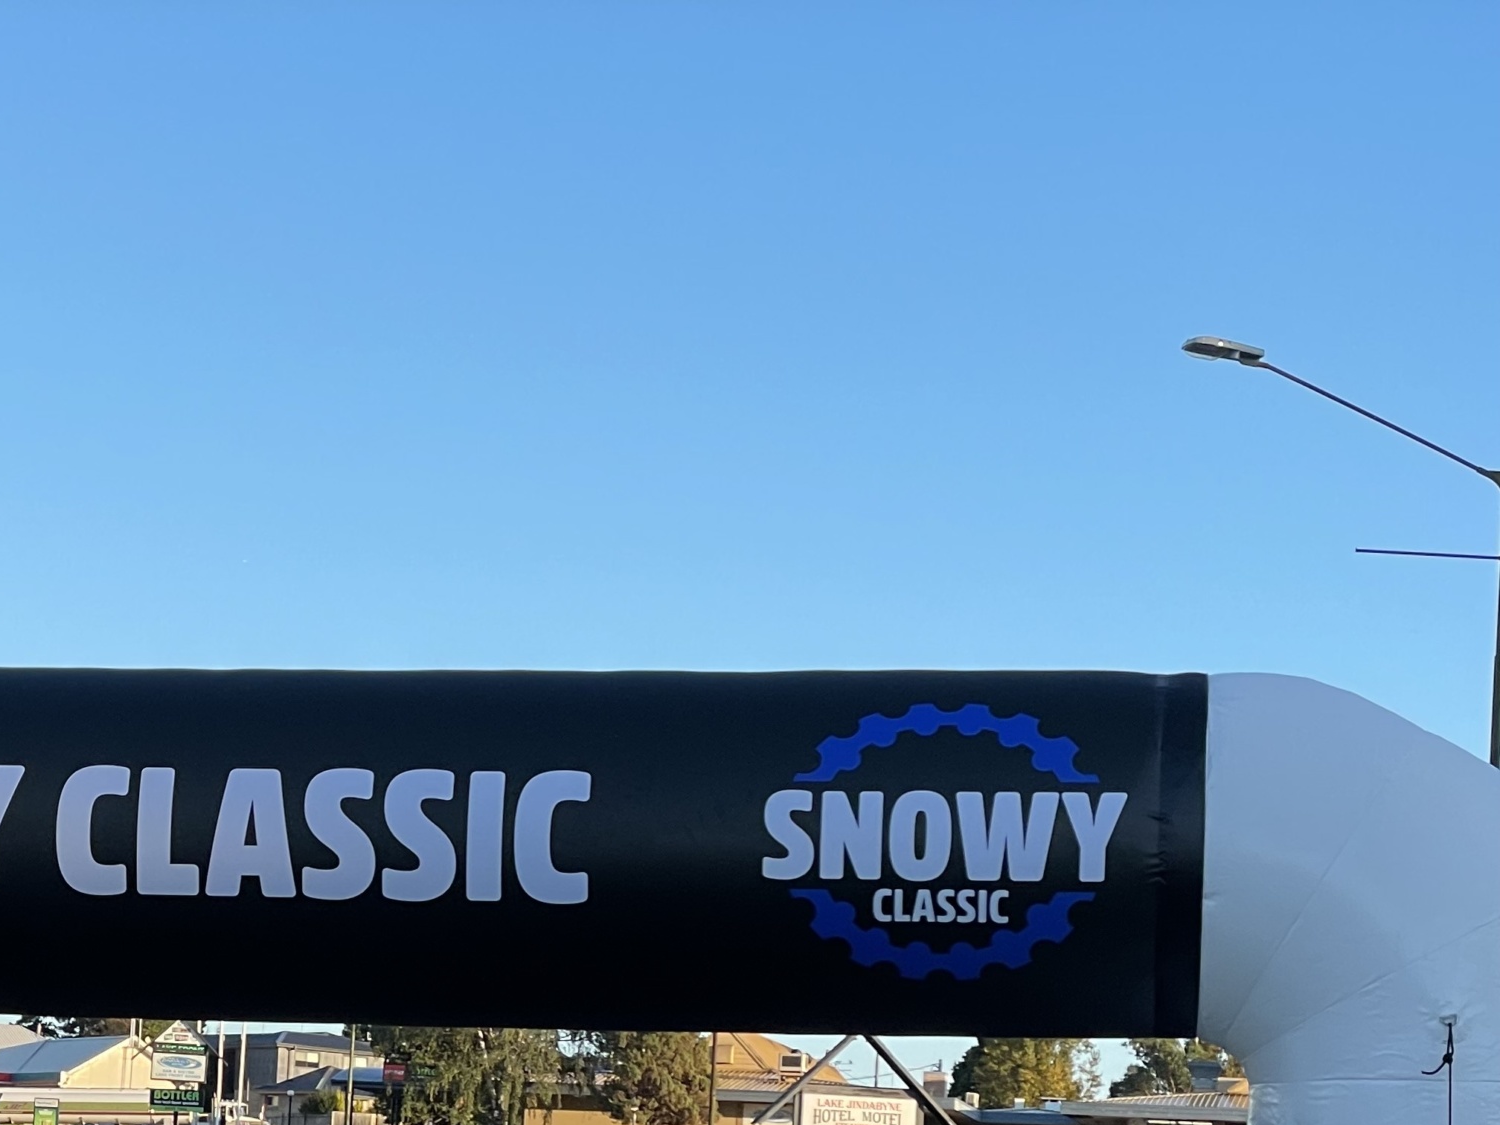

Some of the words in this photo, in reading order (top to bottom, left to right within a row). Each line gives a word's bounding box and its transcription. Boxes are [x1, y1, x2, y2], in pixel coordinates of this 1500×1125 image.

[55, 764, 592, 905] CLASSIC
[761, 789, 1128, 883] SNOWY
[872, 888, 1010, 924] CLASSIC
[813, 1109, 855, 1124] HOTEL
[817, 1099, 844, 1108] LAKE
[846, 1100, 902, 1111] JINDABYNE
